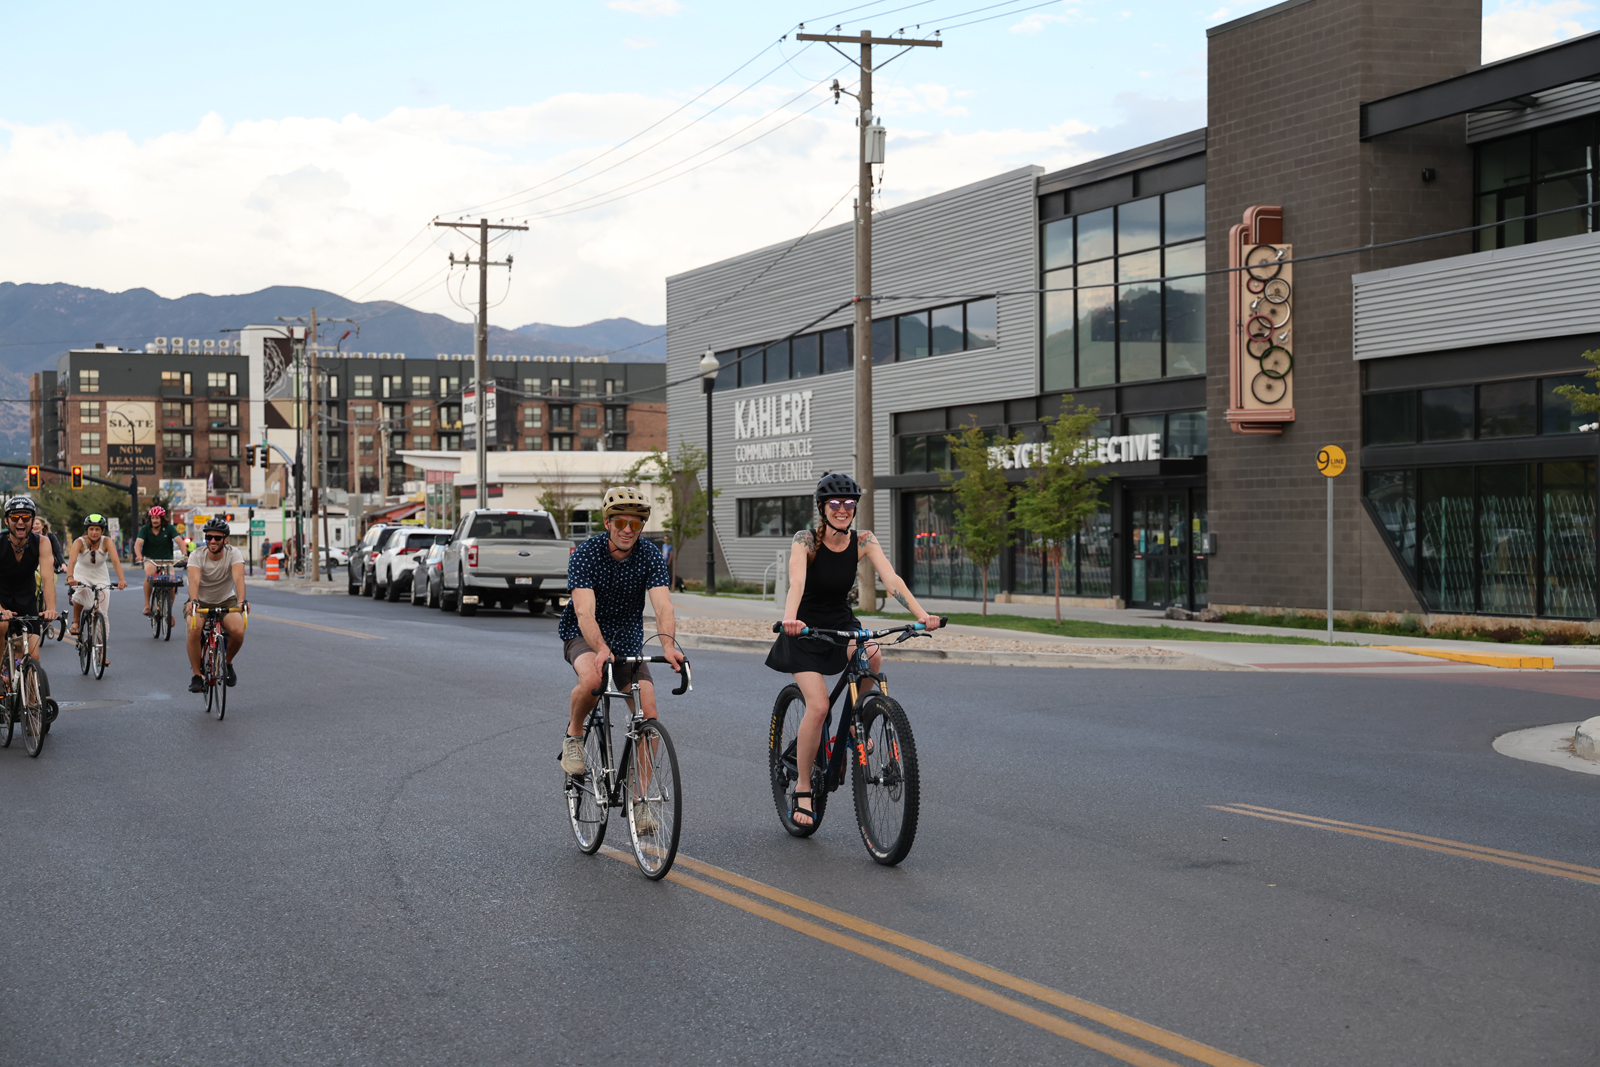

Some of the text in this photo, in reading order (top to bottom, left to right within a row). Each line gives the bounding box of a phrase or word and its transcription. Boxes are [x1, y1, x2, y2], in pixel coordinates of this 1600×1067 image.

[735, 391, 812, 439] KAHLERT
[110, 456, 154, 465] LEASING
[736, 438, 813, 461] COMMUNITY BICYCLE
[1316, 450, 1330, 471] 9
[735, 460, 813, 484] RESOURCE CENTER
[856, 743, 867, 766] FOX
